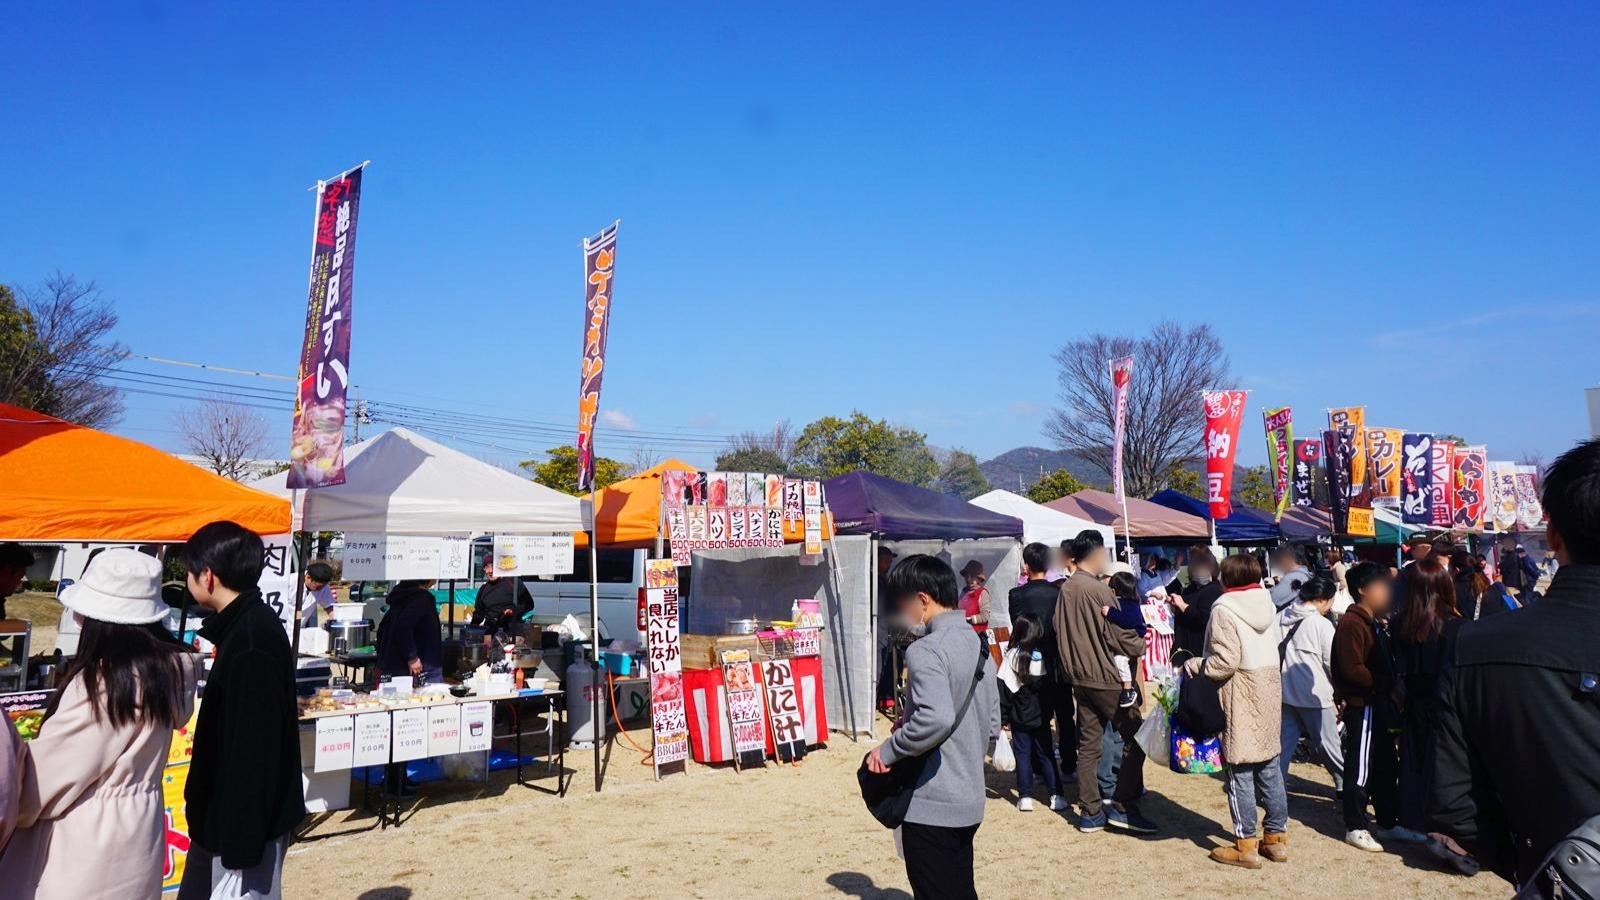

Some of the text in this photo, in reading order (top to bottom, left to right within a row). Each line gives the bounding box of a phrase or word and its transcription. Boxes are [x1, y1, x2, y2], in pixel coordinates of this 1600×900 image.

[316, 201, 350, 398] 絶品肉すい
[1208, 428, 1231, 503] 納豆
[1371, 440, 1395, 494] カレー
[1404, 437, 1432, 515] そば
[1454, 454, 1484, 528] らーめん
[711, 514, 724, 539] ハツ
[732, 511, 744, 539] センマイ
[750, 512, 762, 538] ハチノス
[768, 510, 781, 539] かに汁
[648, 603, 666, 673] 食べれない
[663, 588, 679, 662] 当店でしか
[655, 710, 684, 722] ジューシー
[655, 719, 686, 733] 牛たん
[732, 710, 761, 721] 牛たん
[765, 662, 801, 742] かに汁
